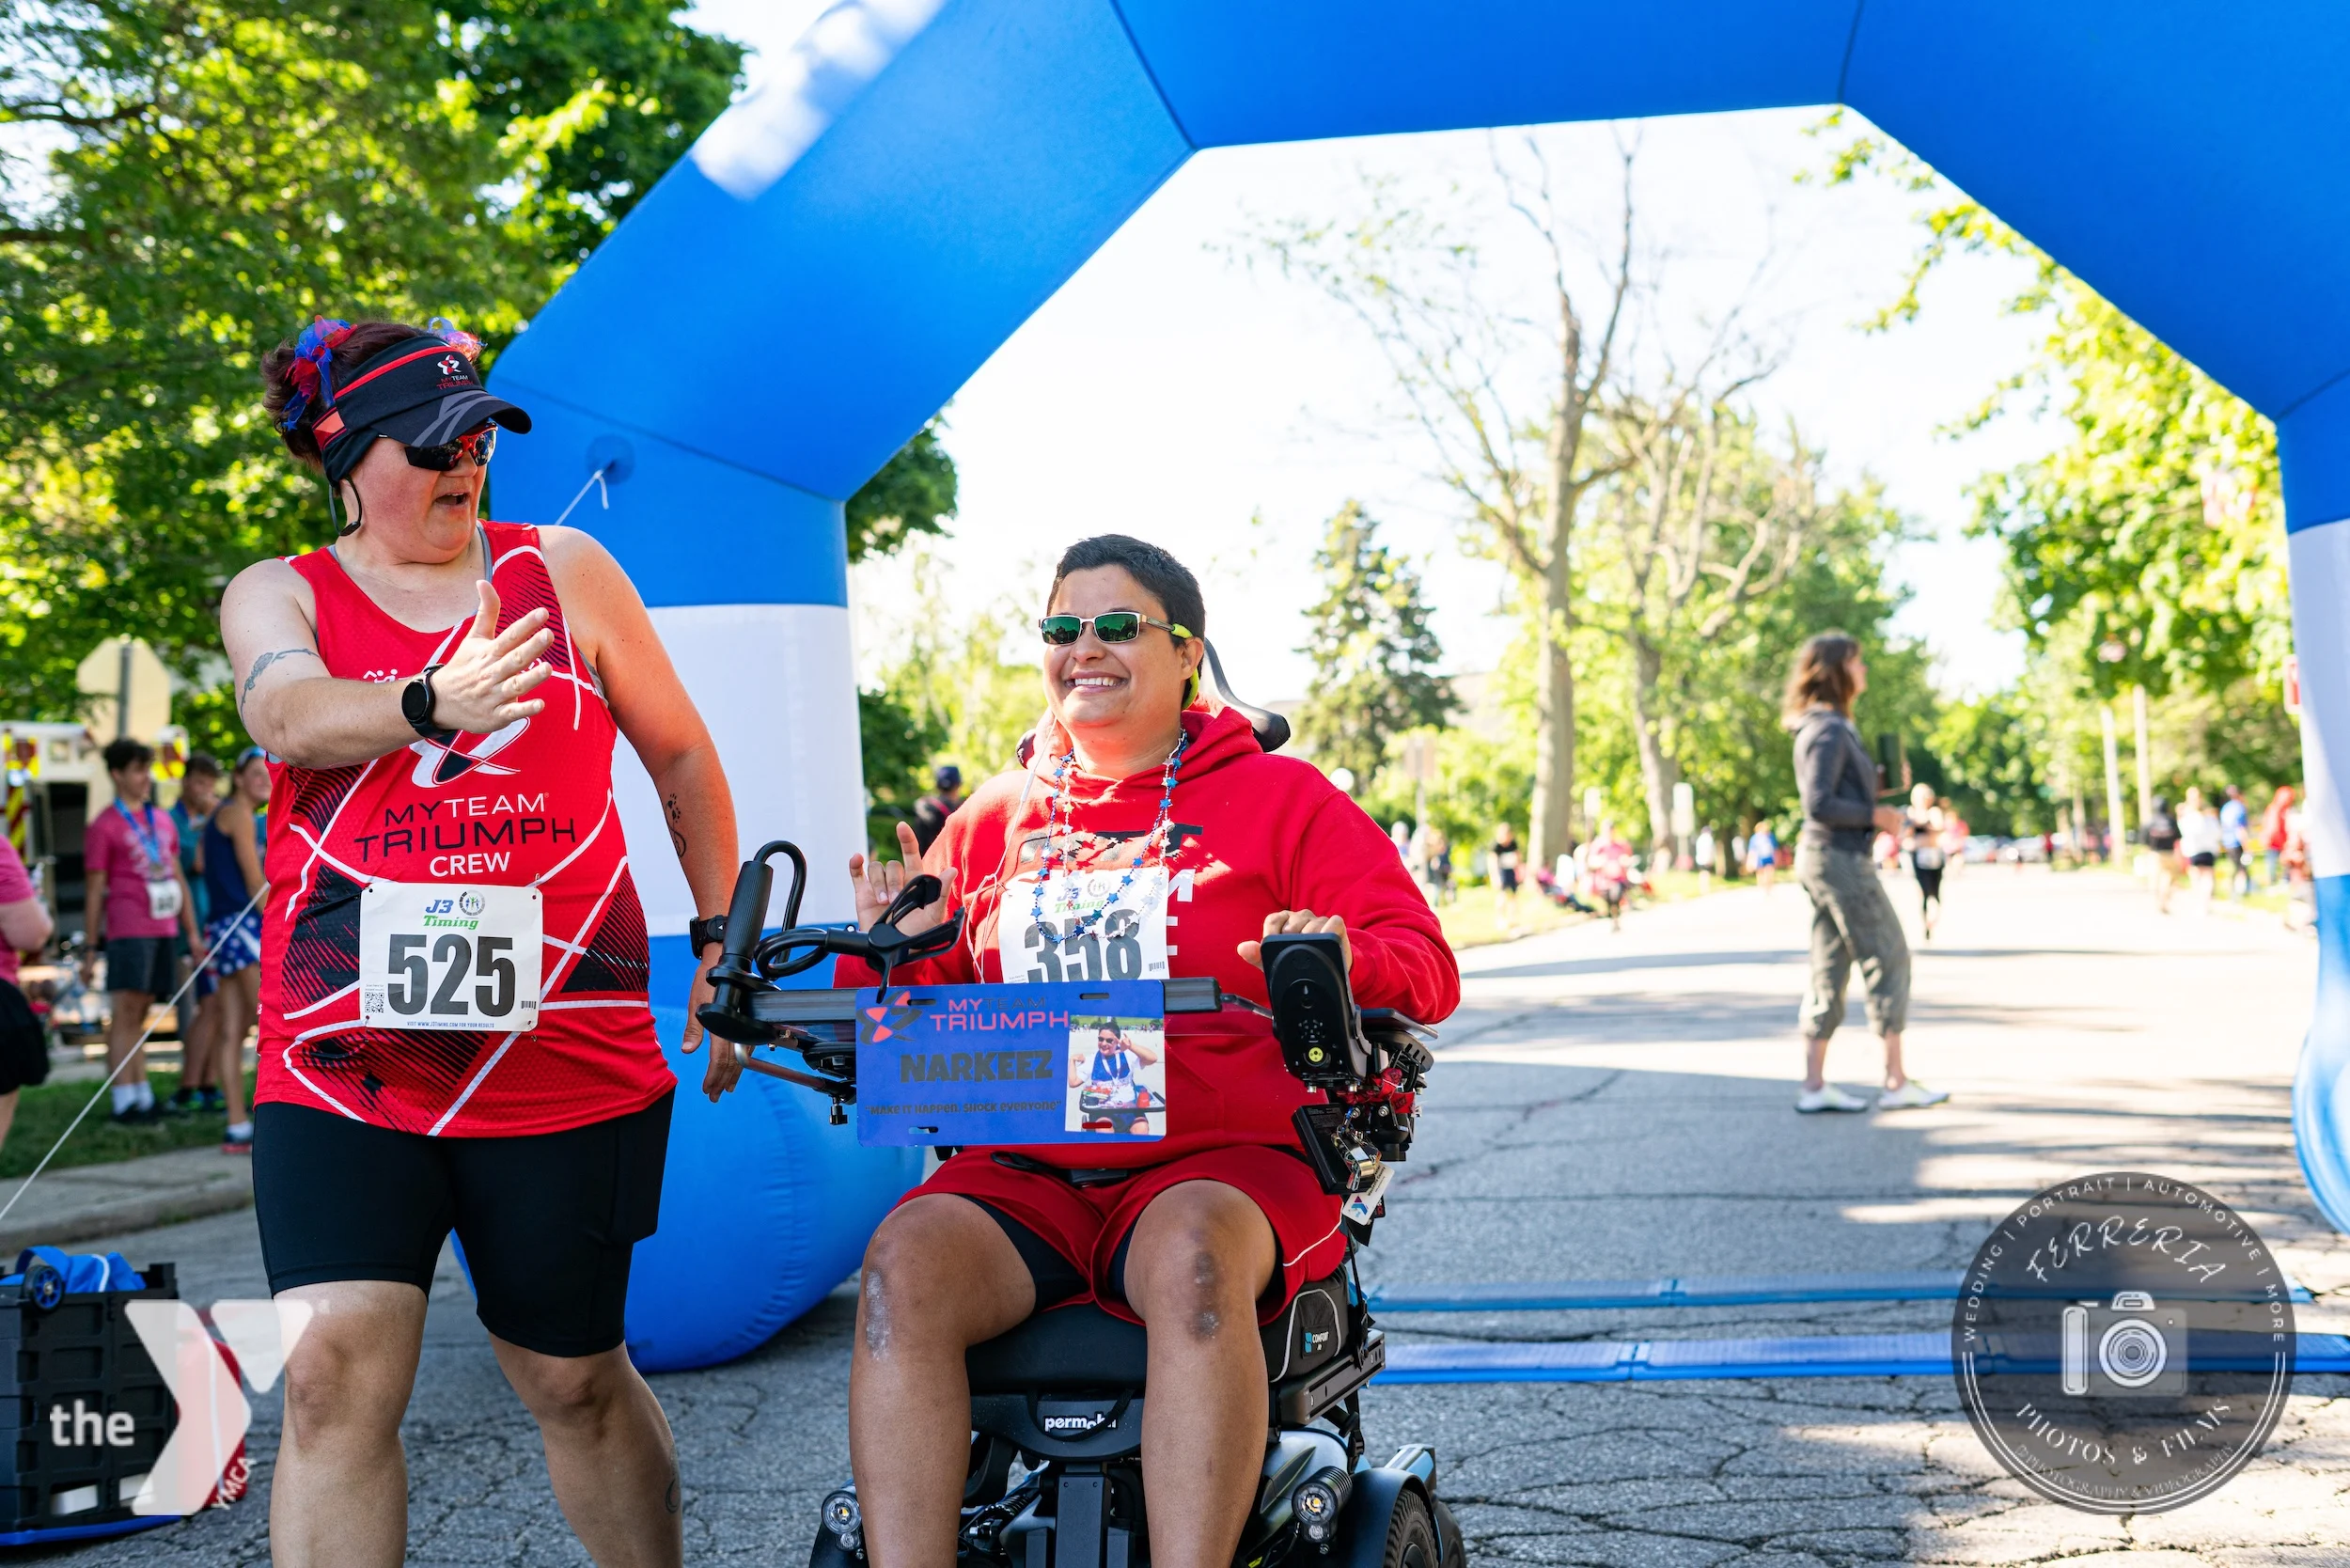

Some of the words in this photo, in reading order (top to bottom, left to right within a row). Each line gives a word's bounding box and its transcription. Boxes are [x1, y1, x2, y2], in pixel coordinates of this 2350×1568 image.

[353, 817, 576, 862] TRIUMPH
[430, 852, 510, 877] CREW
[425, 900, 454, 914] J3
[423, 915, 479, 930] Timing
[1024, 909, 1142, 983] 358
[387, 933, 515, 1017] 525
[929, 1011, 1069, 1032] TRIUMPH
[900, 1050, 1053, 1084] NARKEEZ
